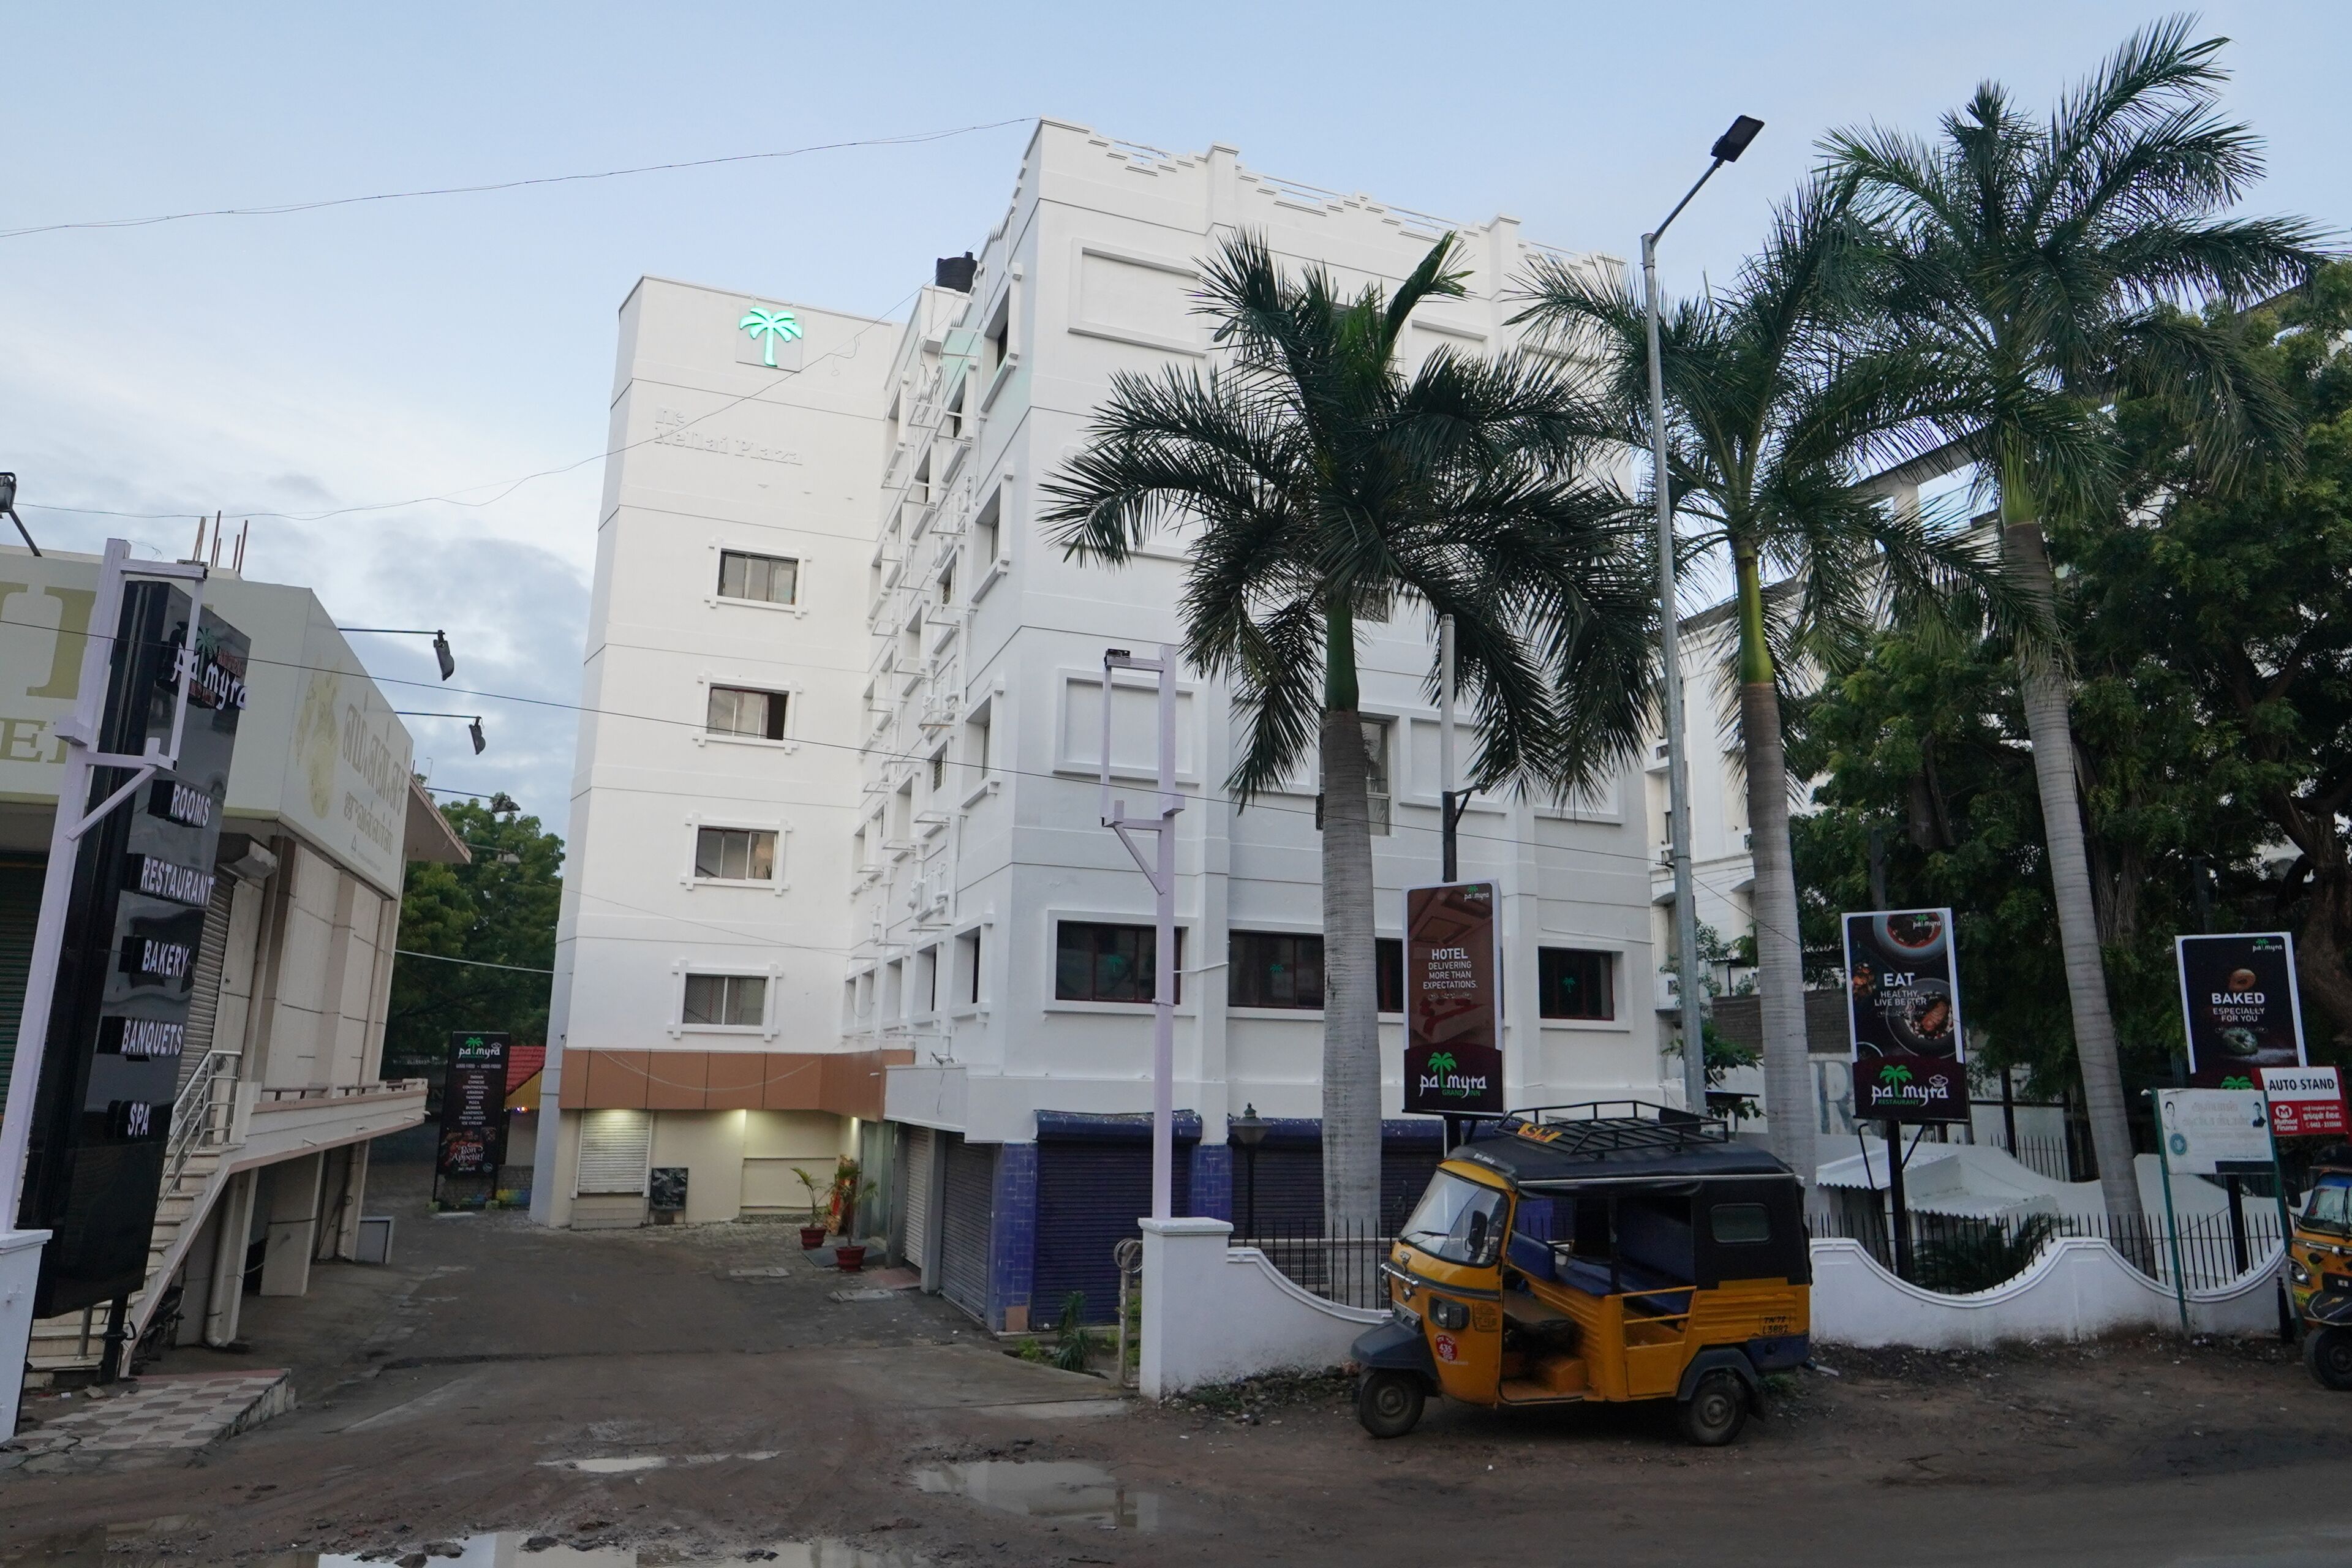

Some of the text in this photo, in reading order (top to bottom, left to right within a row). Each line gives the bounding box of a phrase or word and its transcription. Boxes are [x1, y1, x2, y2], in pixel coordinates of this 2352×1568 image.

[653, 426, 803, 466] Nellai Plaza
[170, 784, 211, 828] ROOMS
[140, 858, 214, 906] RESTAURANT
[142, 940, 190, 978] BAKERY
[1431, 948, 1468, 960] HOTEL
[1428, 961, 1472, 971] DELIVERING
[1429, 970, 1471, 980] MORE THAN
[1884, 972, 1915, 987] EAT
[1423, 980, 1478, 990] EXPECTATIONS.
[1874, 998, 1893, 1006] LIVE
[2212, 992, 2265, 1005] BAKED
[2213, 1007, 2265, 1016] ESPECIALLY
[121, 1019, 183, 1056] BANQUETS
[2269, 1079, 2334, 1091] AUTO STAND
[127, 1103, 150, 1136] SPA
